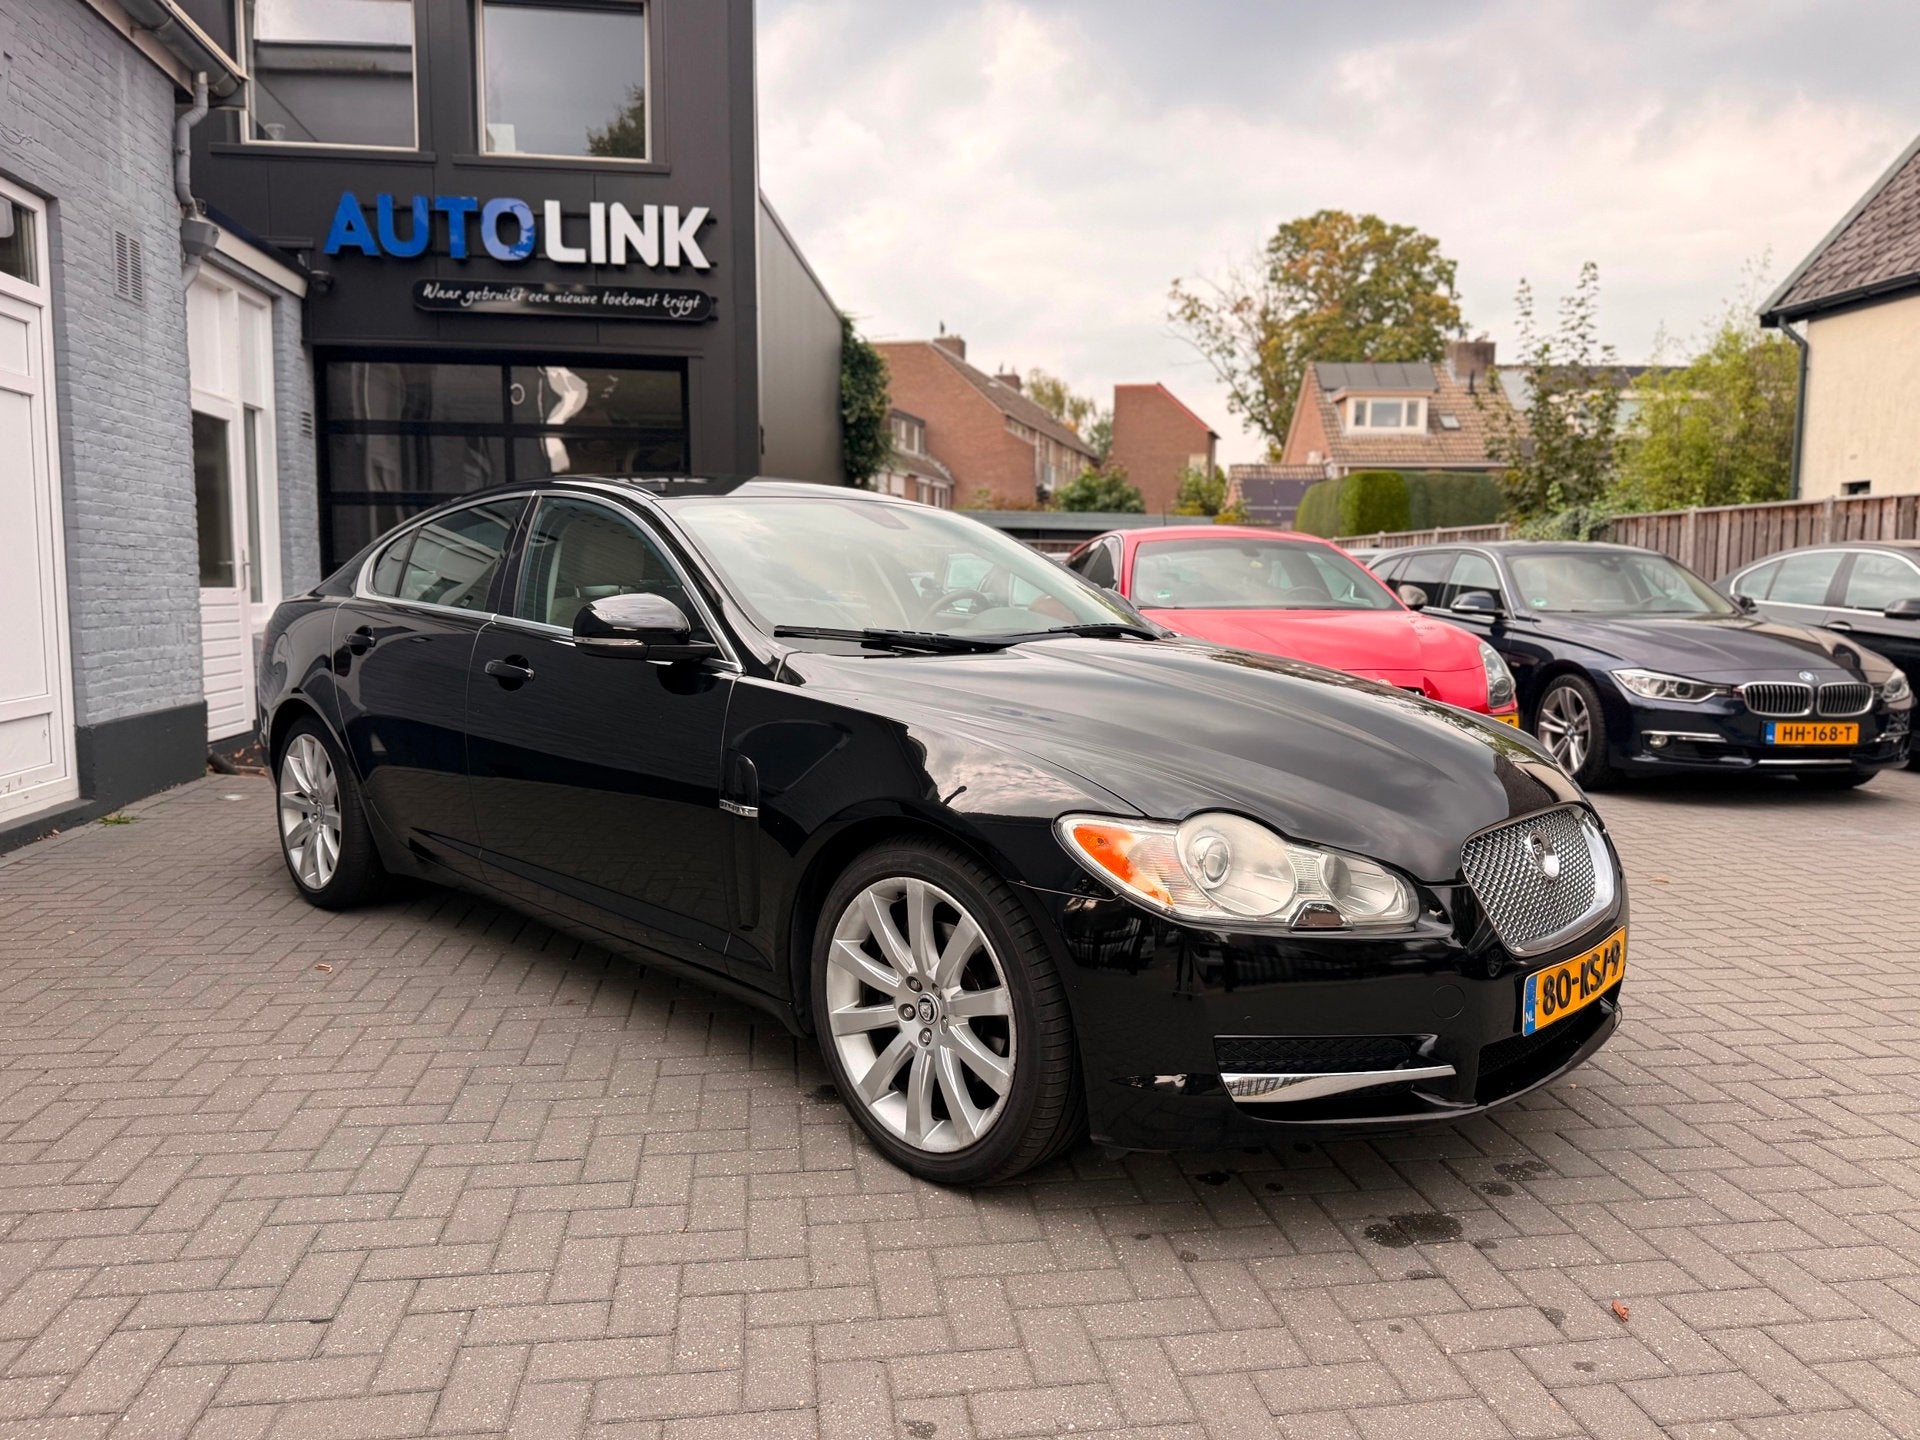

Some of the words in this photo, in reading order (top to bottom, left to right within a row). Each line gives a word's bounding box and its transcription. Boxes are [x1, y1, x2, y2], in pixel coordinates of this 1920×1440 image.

[323, 191, 711, 269] AUTOLINK
[423, 282, 462, 299] Waar
[460, 286, 524, 307] gebruikt
[528, 292, 550, 303] een
[554, 291, 598, 304] nieuwe
[602, 291, 659, 307] toekomst
[662, 293, 701, 318] krijgt
[1782, 726, 1852, 741] HH-168-T
[1542, 939, 1620, 1016] 80-KSJ-9
[1525, 1010, 1534, 1024] NL
